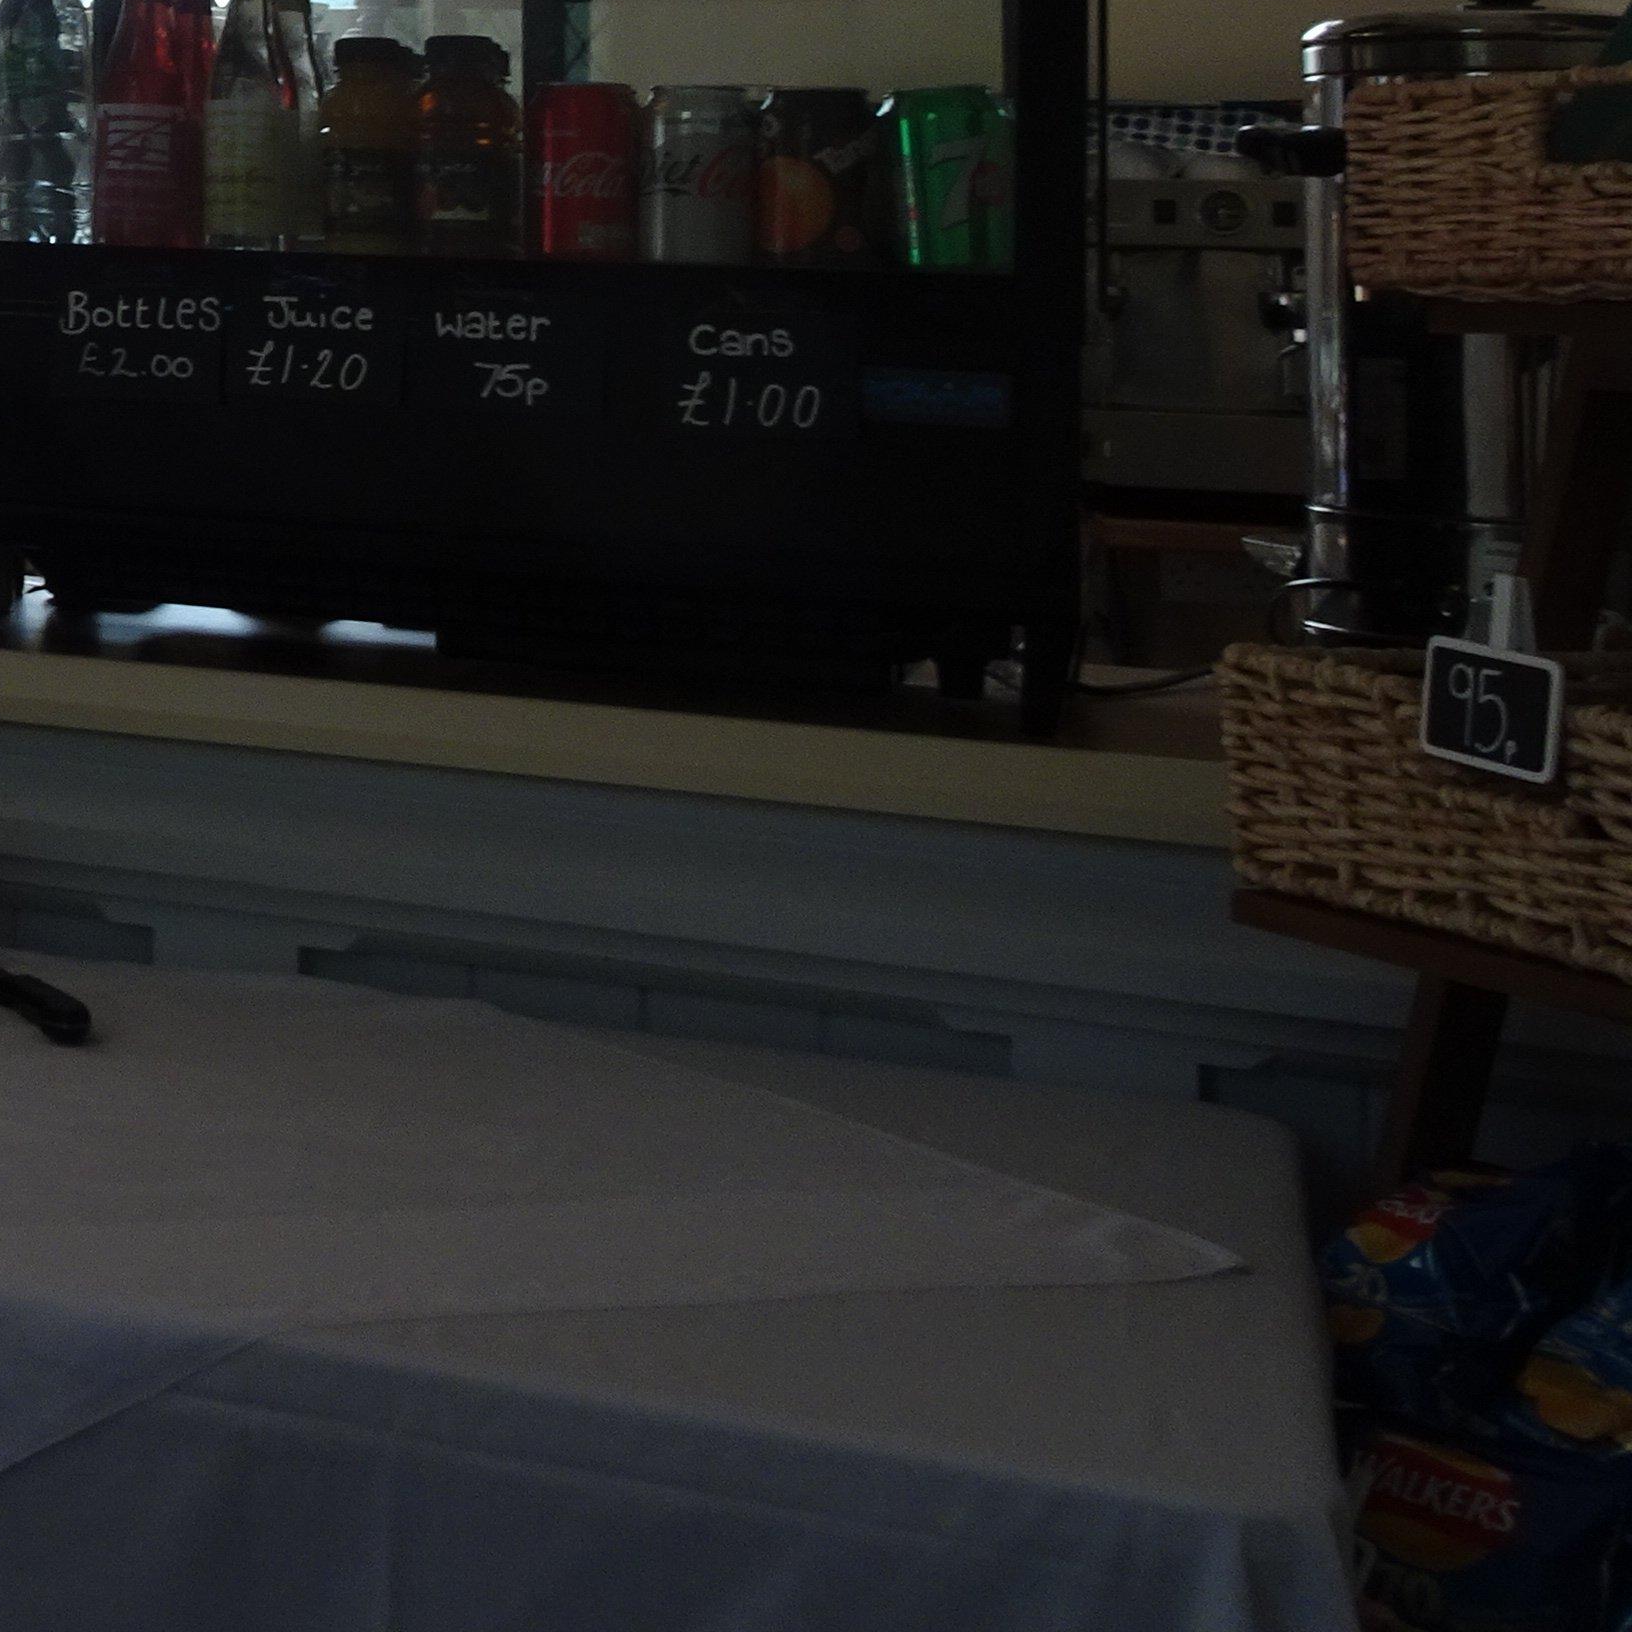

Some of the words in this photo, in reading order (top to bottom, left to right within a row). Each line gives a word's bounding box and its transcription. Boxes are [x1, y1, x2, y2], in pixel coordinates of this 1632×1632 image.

[60, 290, 222, 336] Bottles
[262, 294, 376, 332] Juice
[687, 323, 795, 358] Cans
[79, 341, 195, 380] £2.00
[473, 360, 551, 406] 75p
